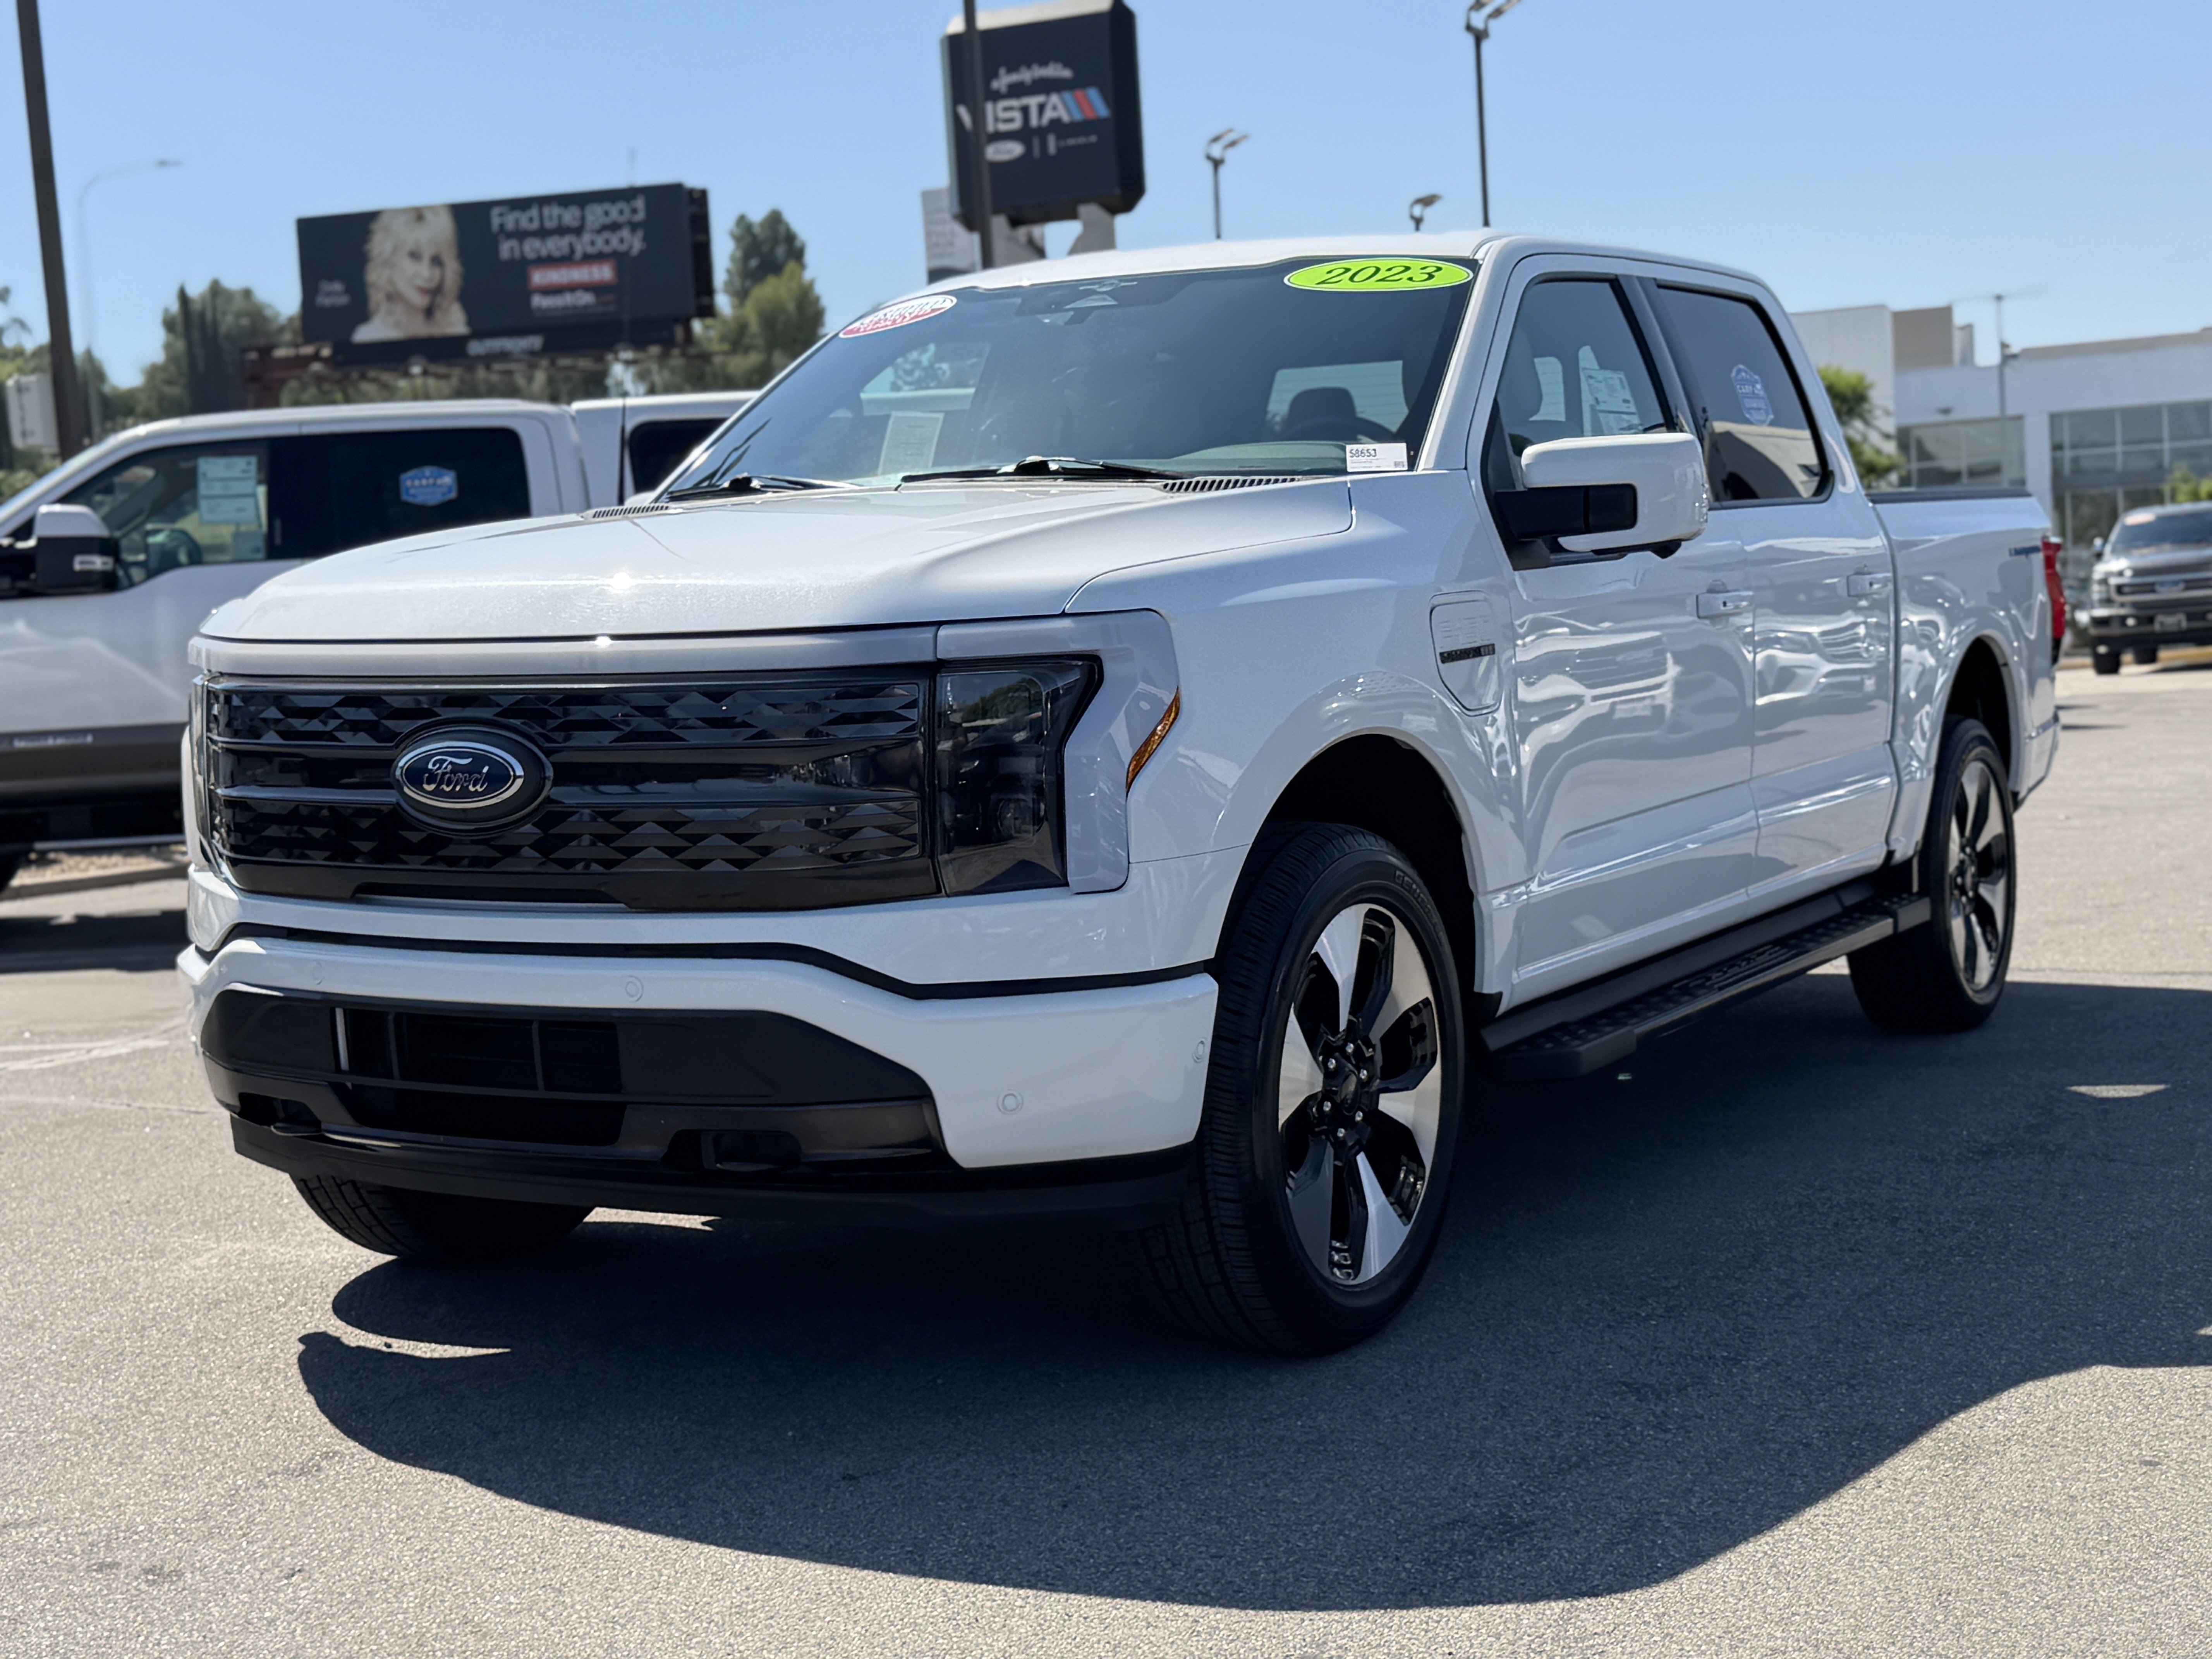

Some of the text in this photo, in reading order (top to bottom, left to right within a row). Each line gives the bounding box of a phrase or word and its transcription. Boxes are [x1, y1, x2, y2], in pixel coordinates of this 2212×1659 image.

[490, 195, 646, 232] Find the good
[498, 234, 521, 261] in
[1315, 265, 1443, 285] 2023
[422, 755, 489, 792] Ford
